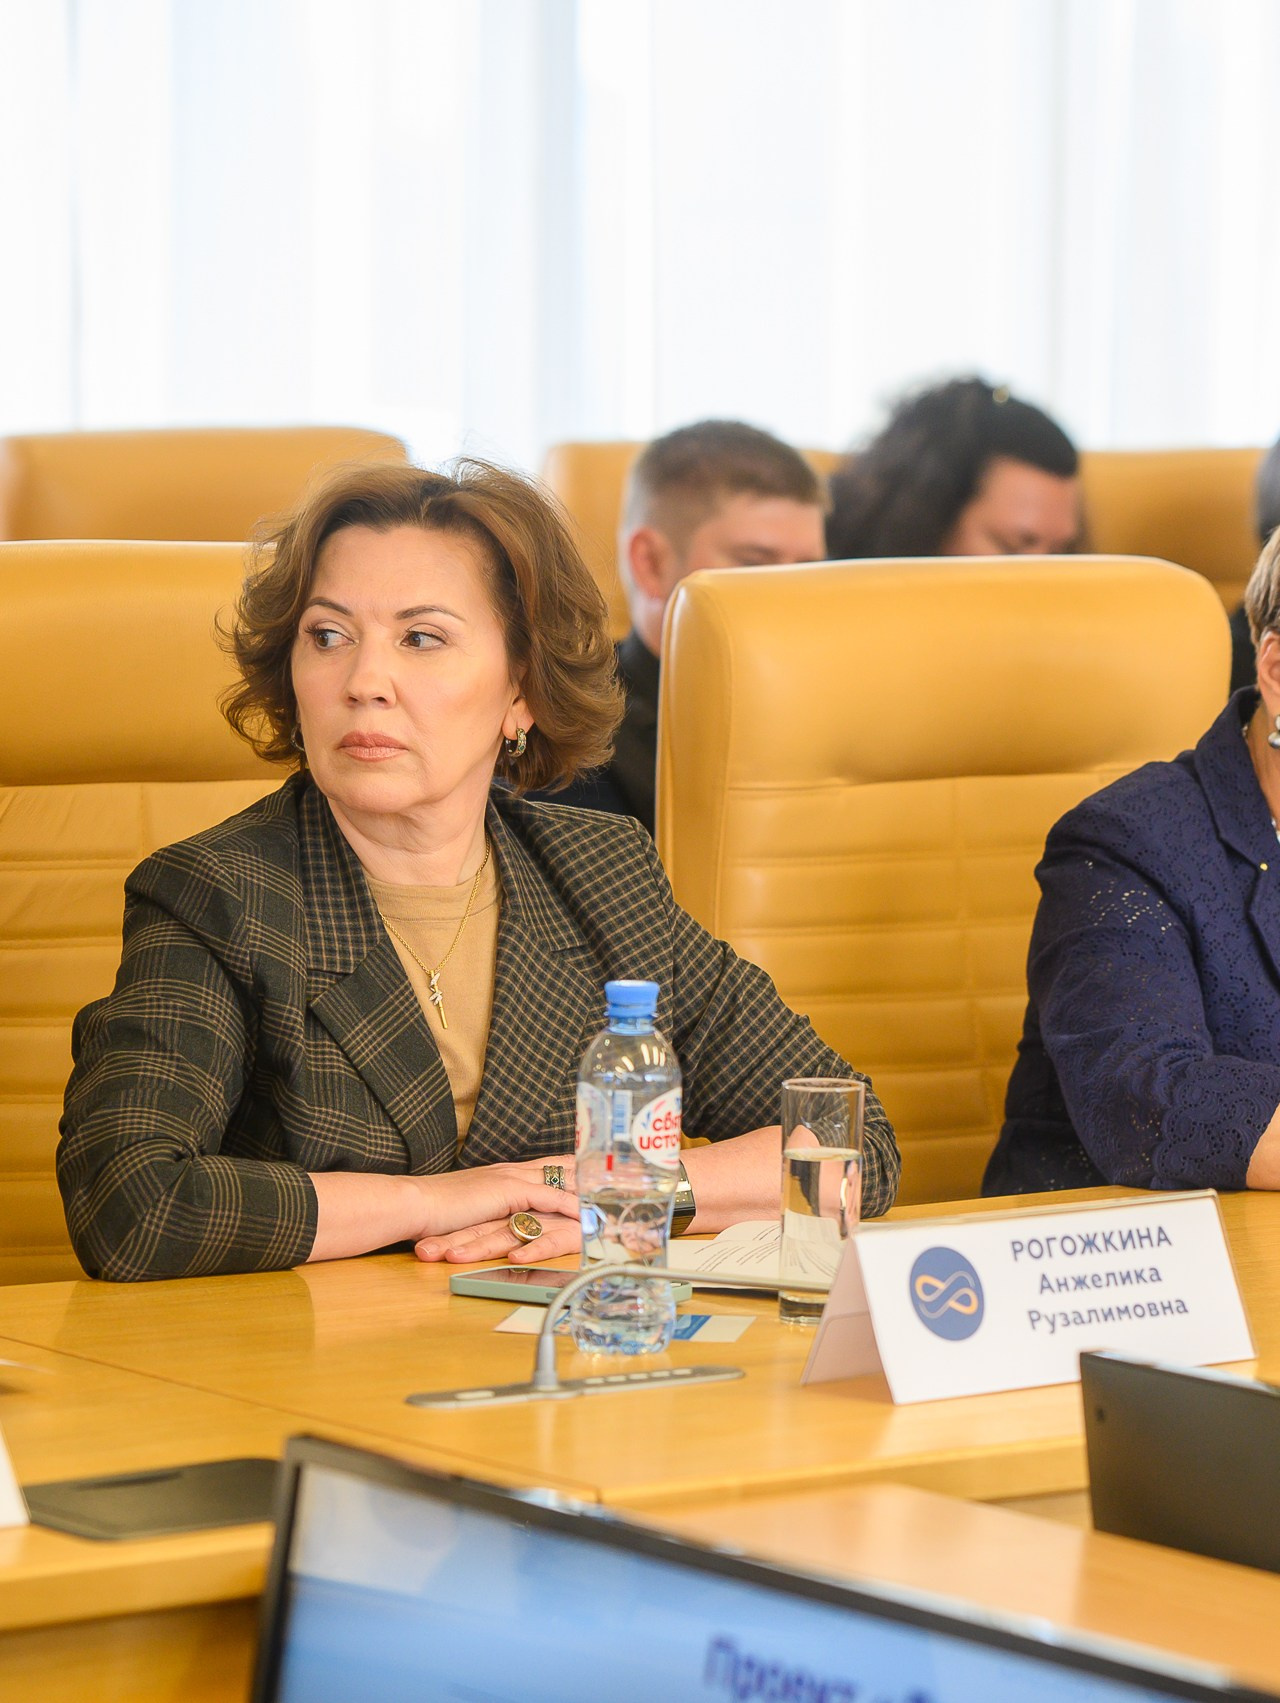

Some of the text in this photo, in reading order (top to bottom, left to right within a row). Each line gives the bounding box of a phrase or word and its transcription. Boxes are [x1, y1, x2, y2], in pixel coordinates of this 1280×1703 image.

[1011, 1226, 1172, 1262] РОГОЖКИНА
[1039, 1266, 1162, 1296] Анжелика
[1028, 1298, 1189, 1334] Рузалимовна
